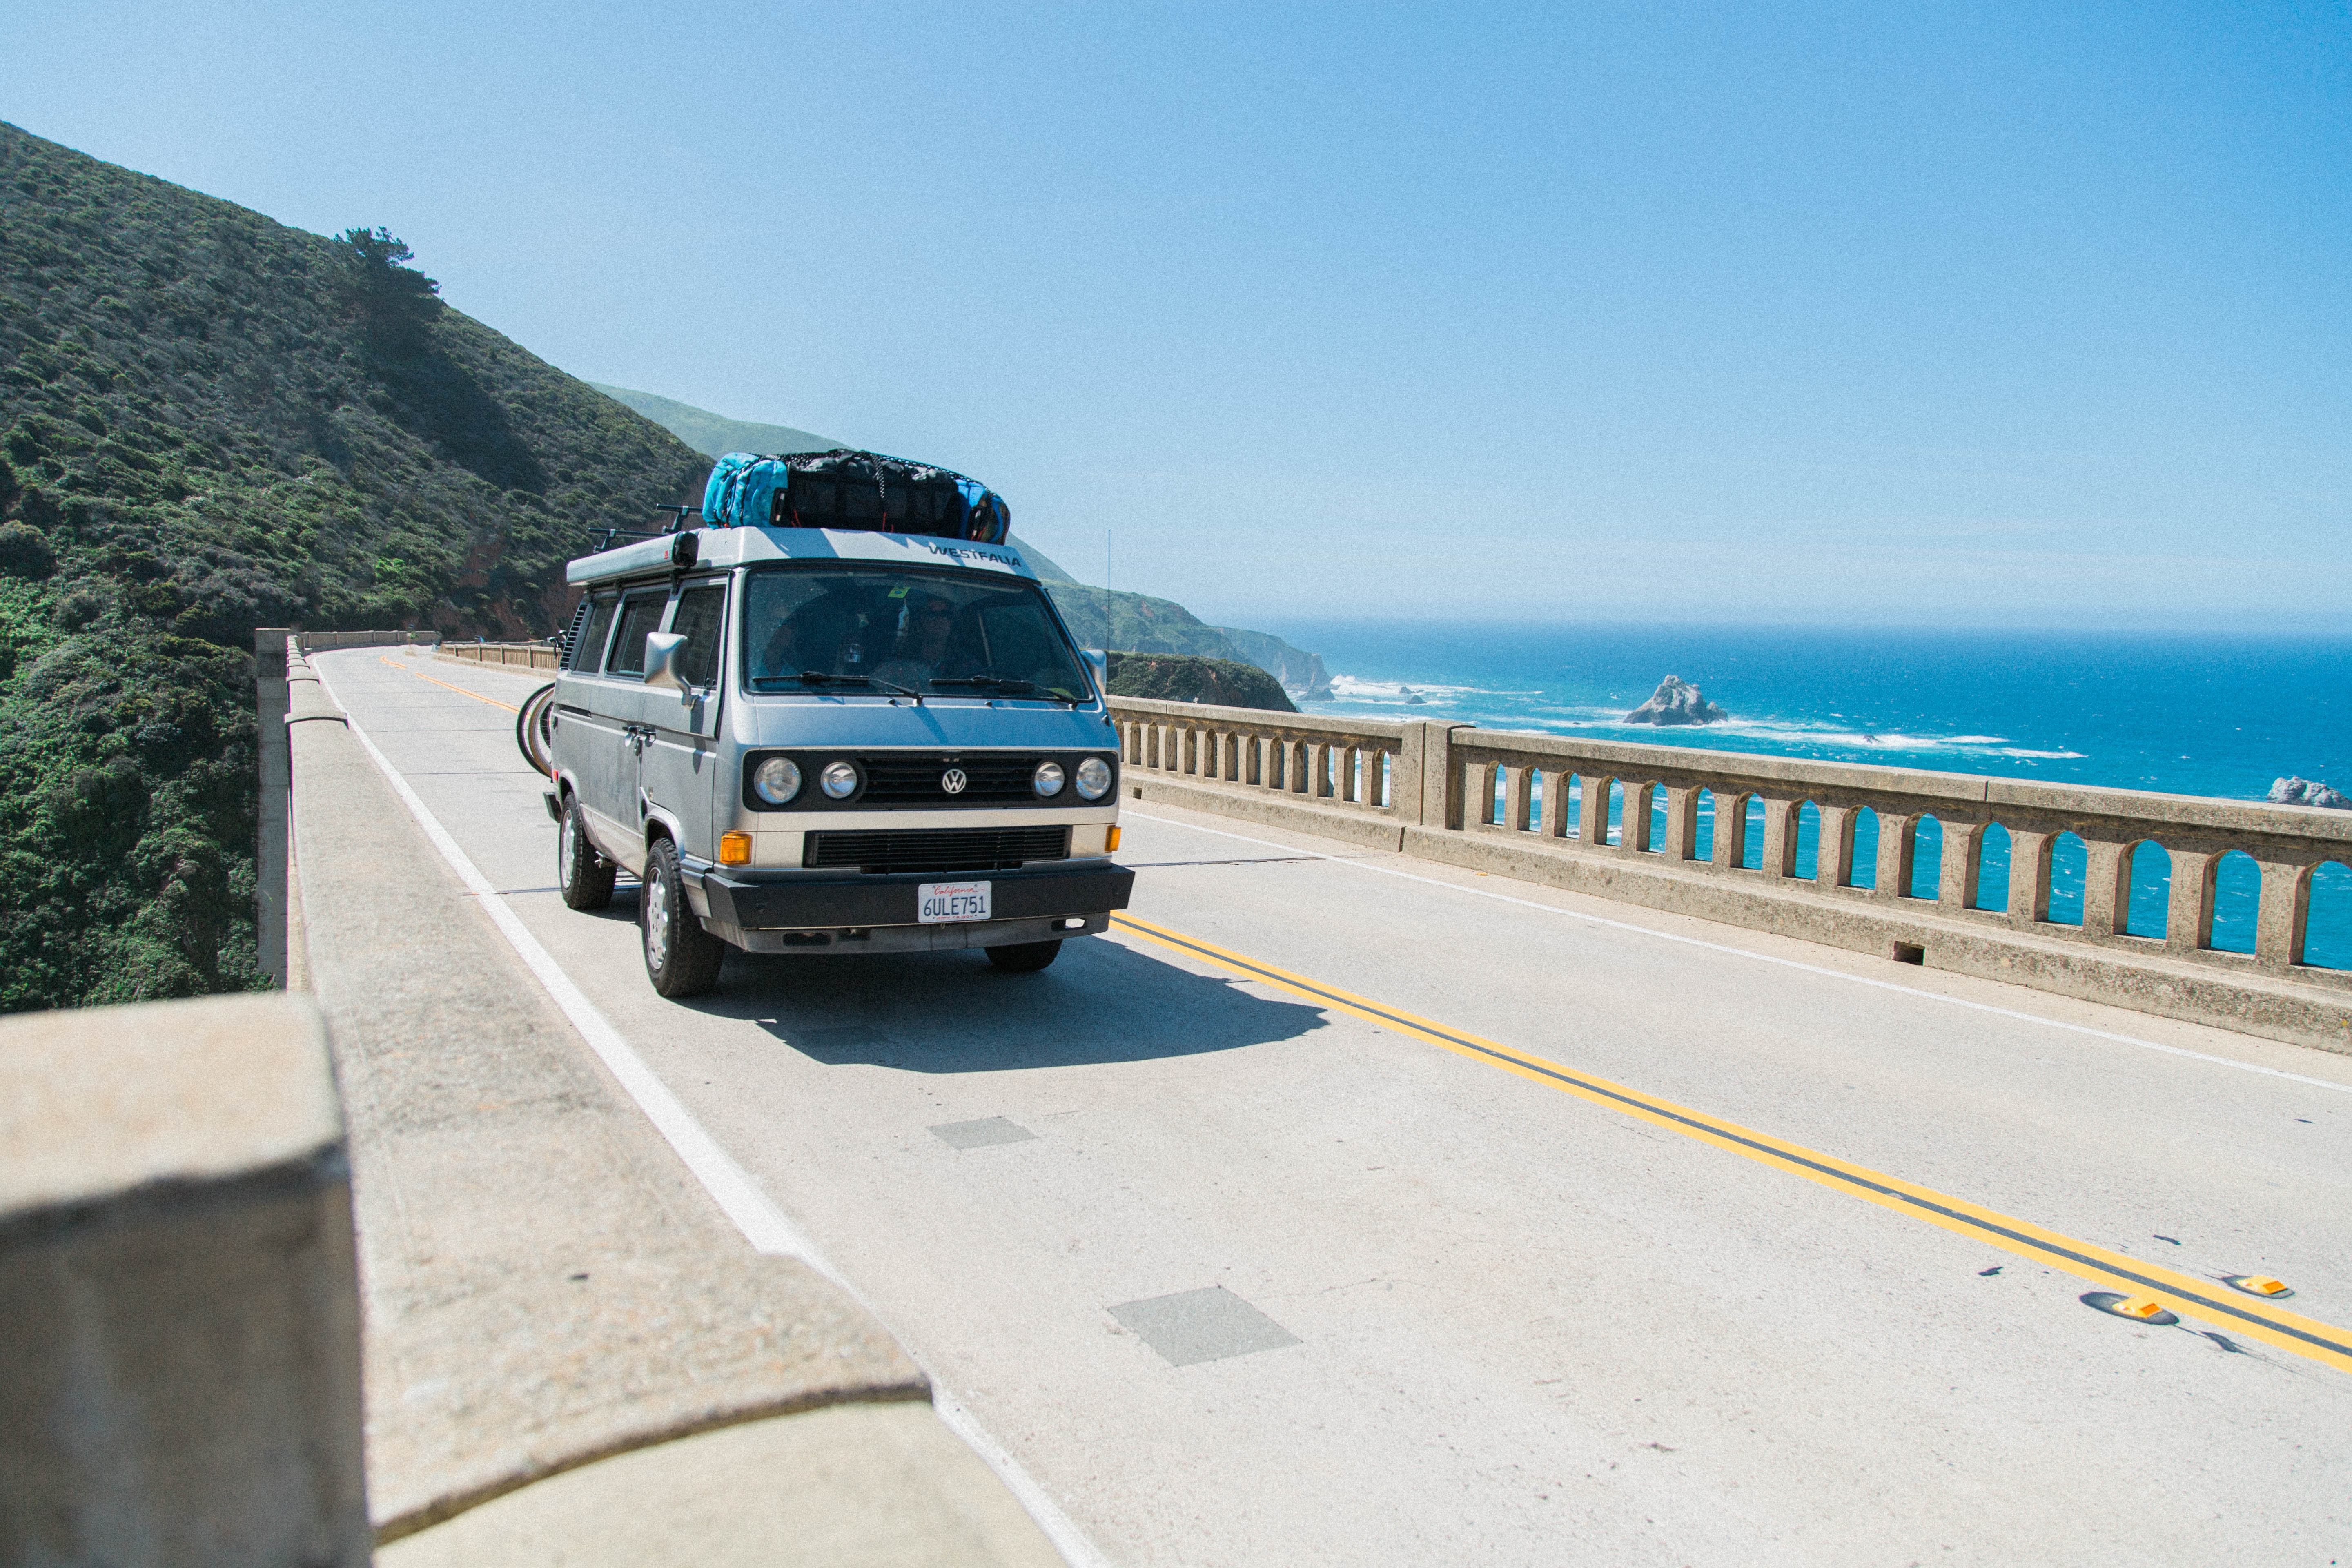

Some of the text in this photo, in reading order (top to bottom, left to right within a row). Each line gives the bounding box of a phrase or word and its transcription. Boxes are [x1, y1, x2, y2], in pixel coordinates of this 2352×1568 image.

[928, 545, 1022, 567] WESTFALIA
[934, 885, 978, 897] California
[924, 896, 986, 916] 6ULE751
